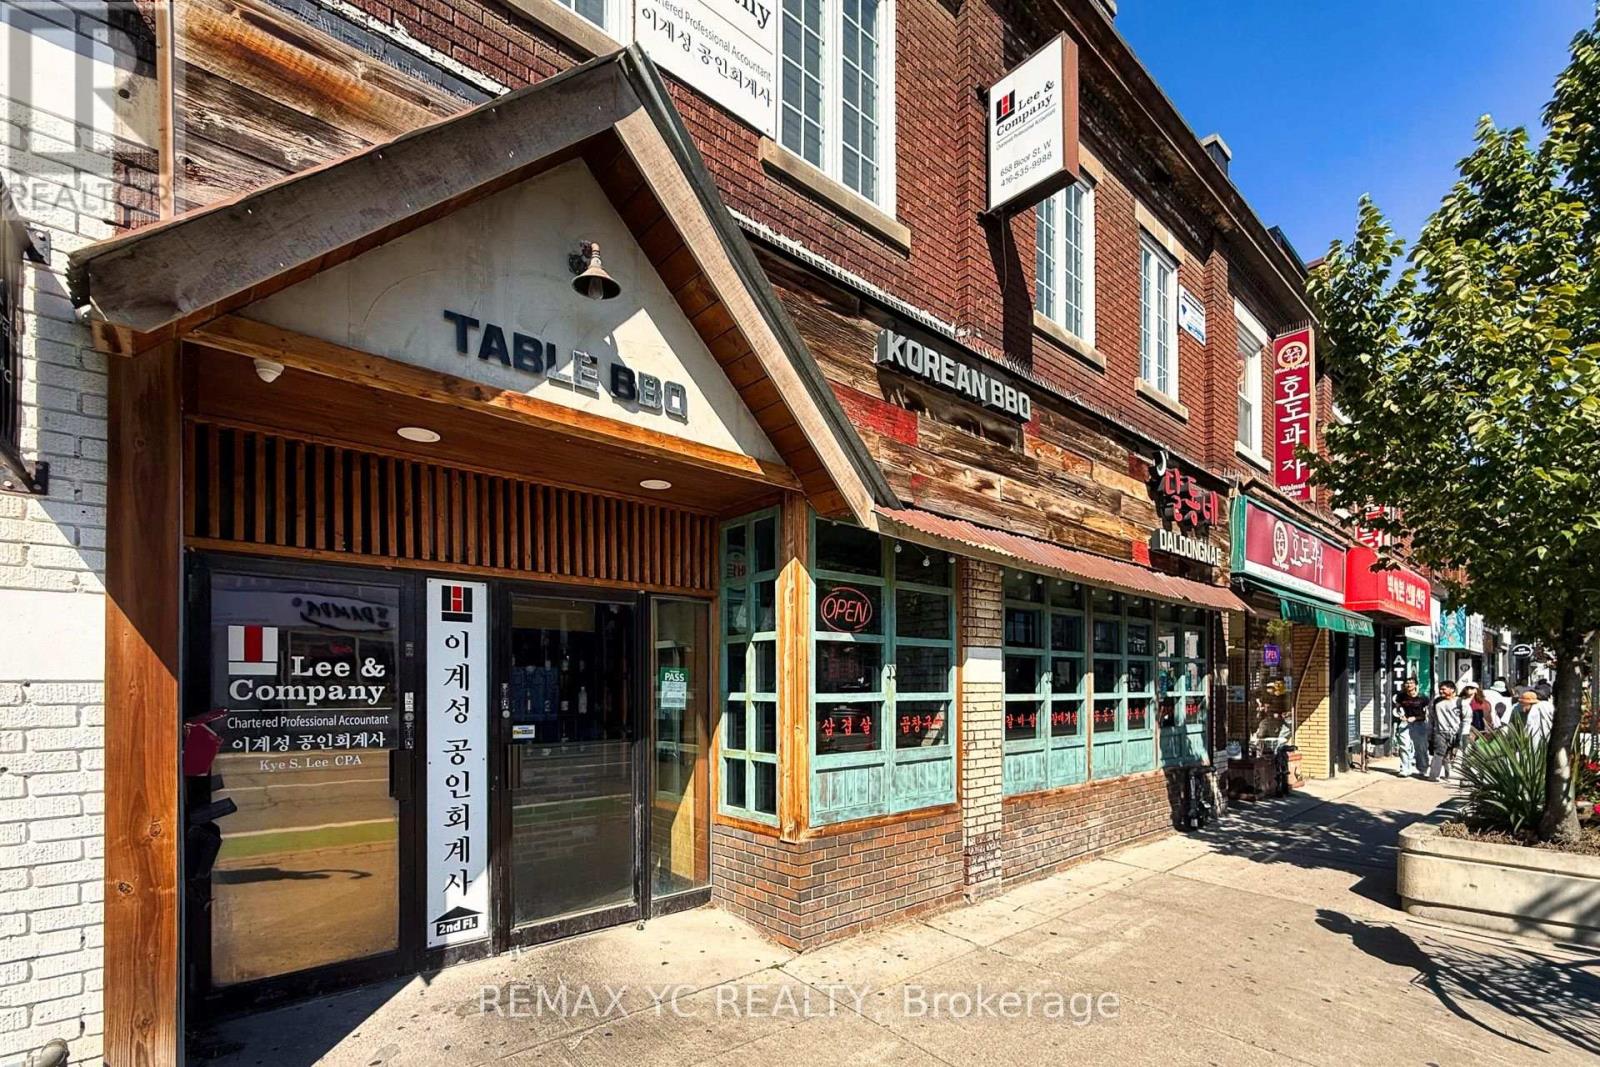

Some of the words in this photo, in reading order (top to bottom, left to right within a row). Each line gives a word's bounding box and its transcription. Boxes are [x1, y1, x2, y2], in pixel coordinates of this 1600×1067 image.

[642, 7, 692, 53] 이계성
[696, 42, 773, 108] 공인회계사
[685, 11, 731, 53] Professional
[731, 44, 772, 83] Accountant
[1018, 89, 1041, 112] Lee
[1043, 80, 1055, 94] &
[996, 93, 1054, 137] Company
[1014, 154, 1031, 169] Bloor
[443, 309, 600, 394] TABLE
[880, 328, 987, 402] KOREAN
[1274, 374, 1311, 481] 호도과자
[1159, 527, 1222, 567] DALDONGNAE
[823, 596, 869, 624] OPEN
[290, 655, 351, 678] Lee
[361, 656, 386, 678] &
[443, 630, 470, 724] 이계성
[664, 672, 685, 682] PASS
[229, 679, 386, 706] Company
[227, 716, 279, 729] Chartered
[280, 715, 337, 728] Professional
[338, 713, 389, 726] Accountant
[231, 734, 290, 754] 이계성
[296, 731, 387, 751] 공인회계사
[259, 759, 287, 773] Kye
[289, 758, 302, 769] S.
[305, 757, 329, 768] Lee
[334, 755, 362, 767] CPA
[442, 738, 473, 898] 공인회계사
[439, 919, 461, 934] 2nd
[462, 917, 476, 930] Fl.
